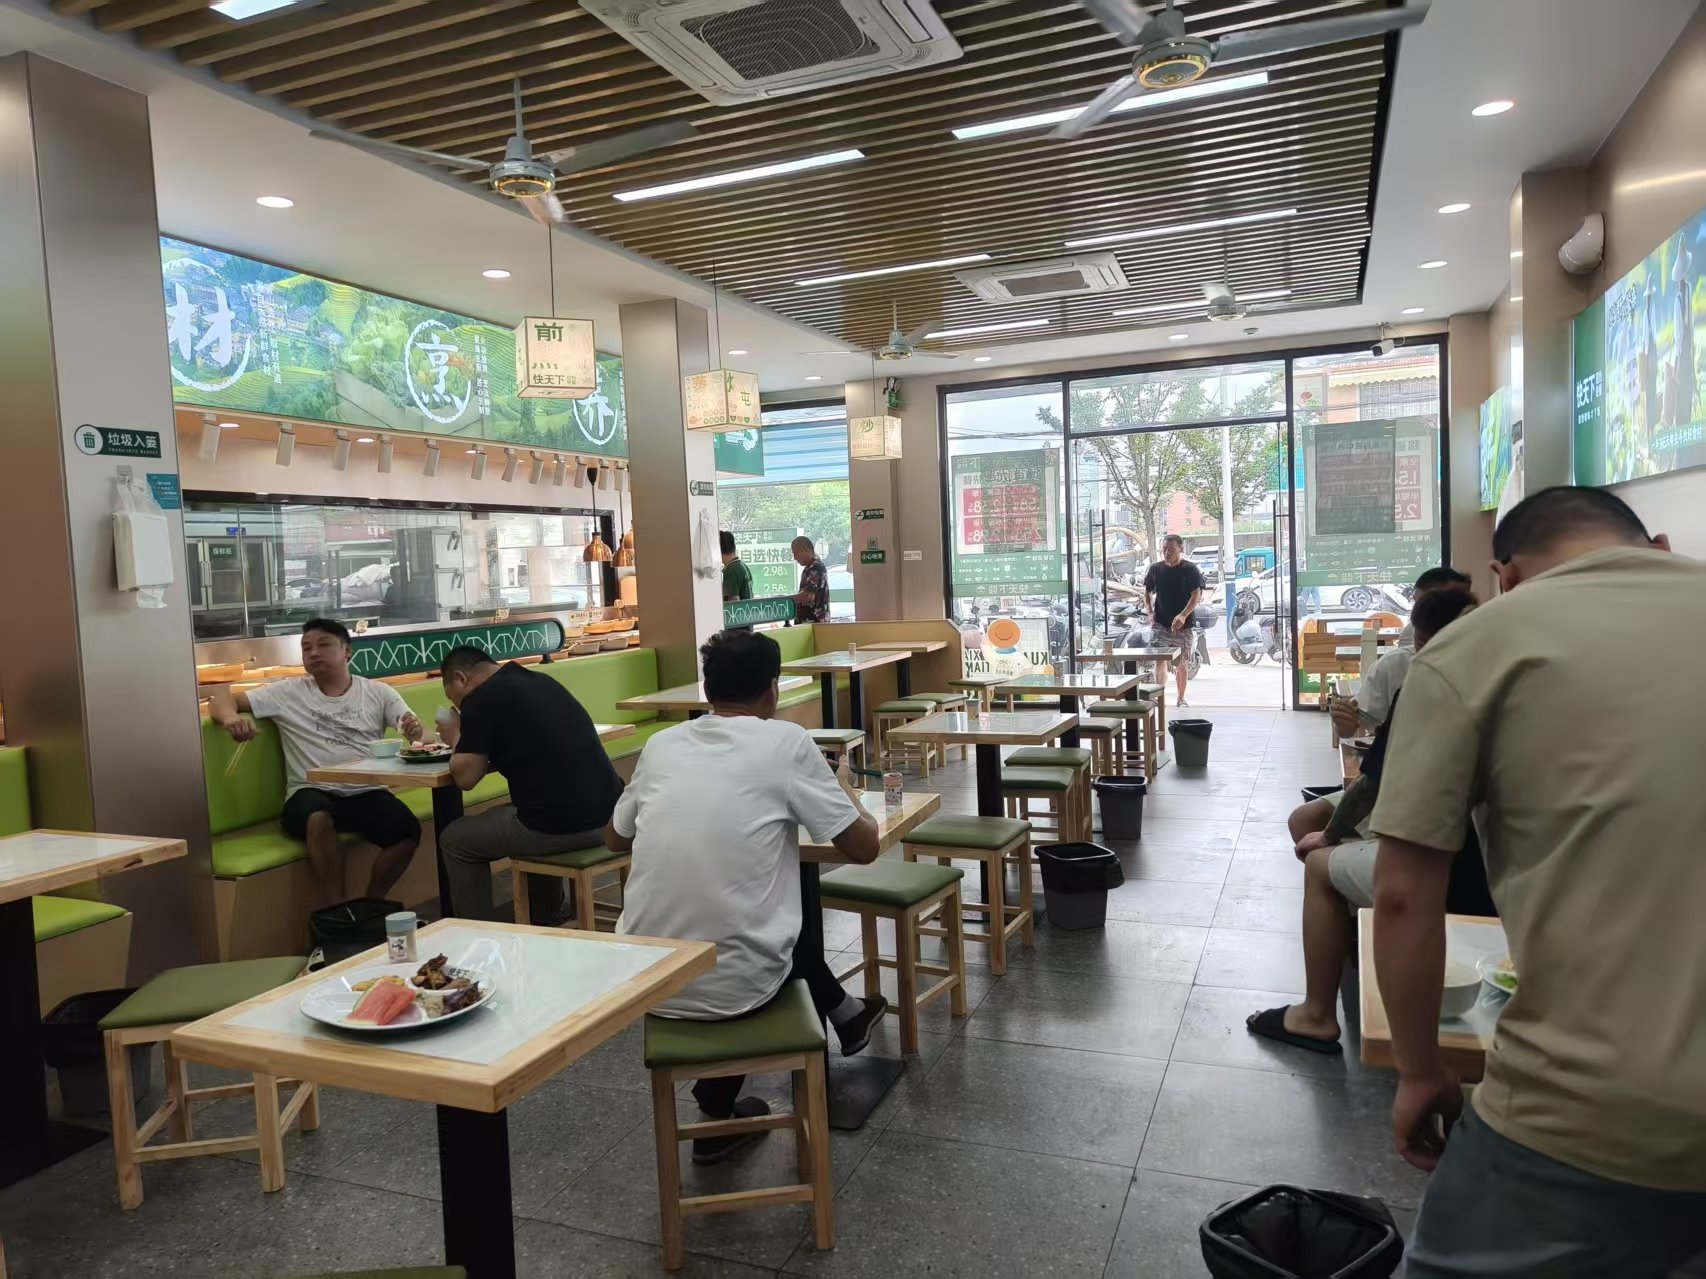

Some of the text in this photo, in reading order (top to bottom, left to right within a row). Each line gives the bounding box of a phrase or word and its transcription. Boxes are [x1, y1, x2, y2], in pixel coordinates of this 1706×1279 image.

[165, 282, 236, 368] 材
[415, 332, 463, 412] 烹
[533, 374, 565, 385] 快天下
[1576, 372, 1596, 408] 快天下
[107, 432, 158, 449] 垃圾入篓
[736, 547, 793, 563] 自选快餐
[763, 566, 784, 577] 2.98
